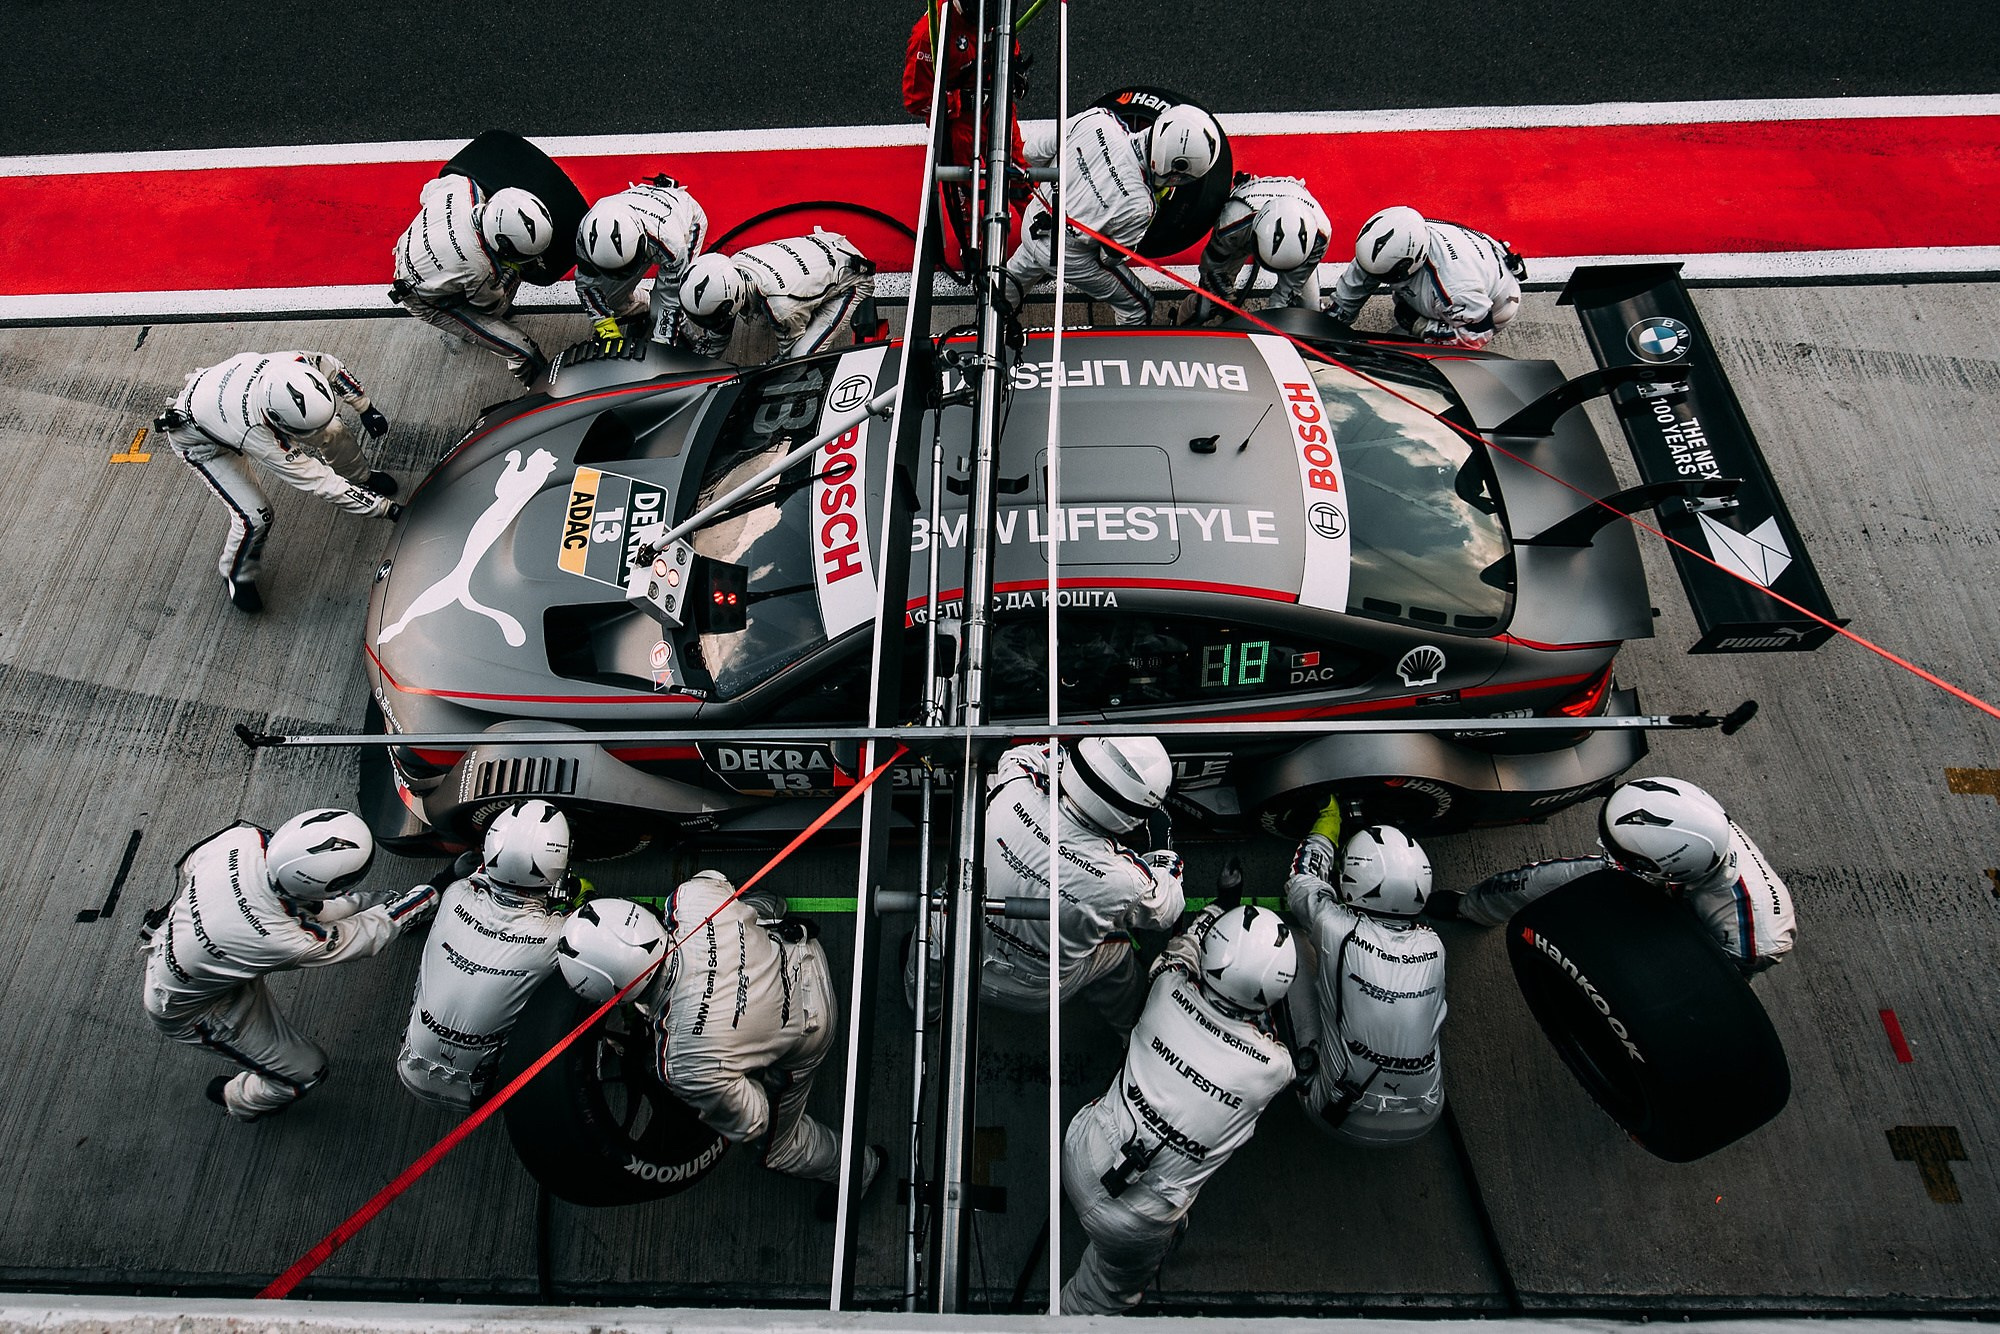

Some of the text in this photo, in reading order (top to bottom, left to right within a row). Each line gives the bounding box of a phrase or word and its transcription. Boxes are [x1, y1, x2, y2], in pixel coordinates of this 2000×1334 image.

[1096, 128, 1129, 197] BMW Team Schnitzer
[774, 272, 786, 289] BMW
[753, 368, 824, 434] 13
[1140, 359, 1250, 392] BMW
[1283, 383, 1338, 493] BOSCH
[1650, 397, 1697, 476] 100 YEARS
[1679, 417, 1722, 481] THE NEX
[563, 491, 596, 550] ADAC
[591, 507, 625, 544] 13
[820, 423, 864, 585] BOSCH
[1028, 506, 1280, 545] LIFESTYLE
[1006, 592, 1036, 610] ДА
[1290, 667, 1334, 684] DAC
[718, 748, 831, 771] DEKRA
[767, 773, 812, 790] 13
[893, 768, 955, 786] BM
[1012, 802, 1106, 880] BMW Tea Schnitzer
[228, 848, 270, 938] BMW Team Schnitzer
[1004, 847, 1081, 904] PERFORMNCE
[1768, 884, 1780, 915] BMW
[191, 904, 226, 961] LIFESTYLE
[453, 903, 548, 946] BMW Team Schnitzer
[1350, 934, 1375, 954] BMW
[1376, 949, 1401, 964] Team
[446, 955, 478, 977] PARTS
[692, 999, 710, 1036] BMW
[703, 969, 717, 999] Team
[1171, 989, 1271, 1066] BMW Team Schnitzer
[1534, 934, 1646, 1064] Hankook
[1151, 1037, 1243, 1110] BMW LIFESTYLE
[1135, 1093, 1211, 1160] Hankook
[624, 1136, 723, 1183] Hankook
